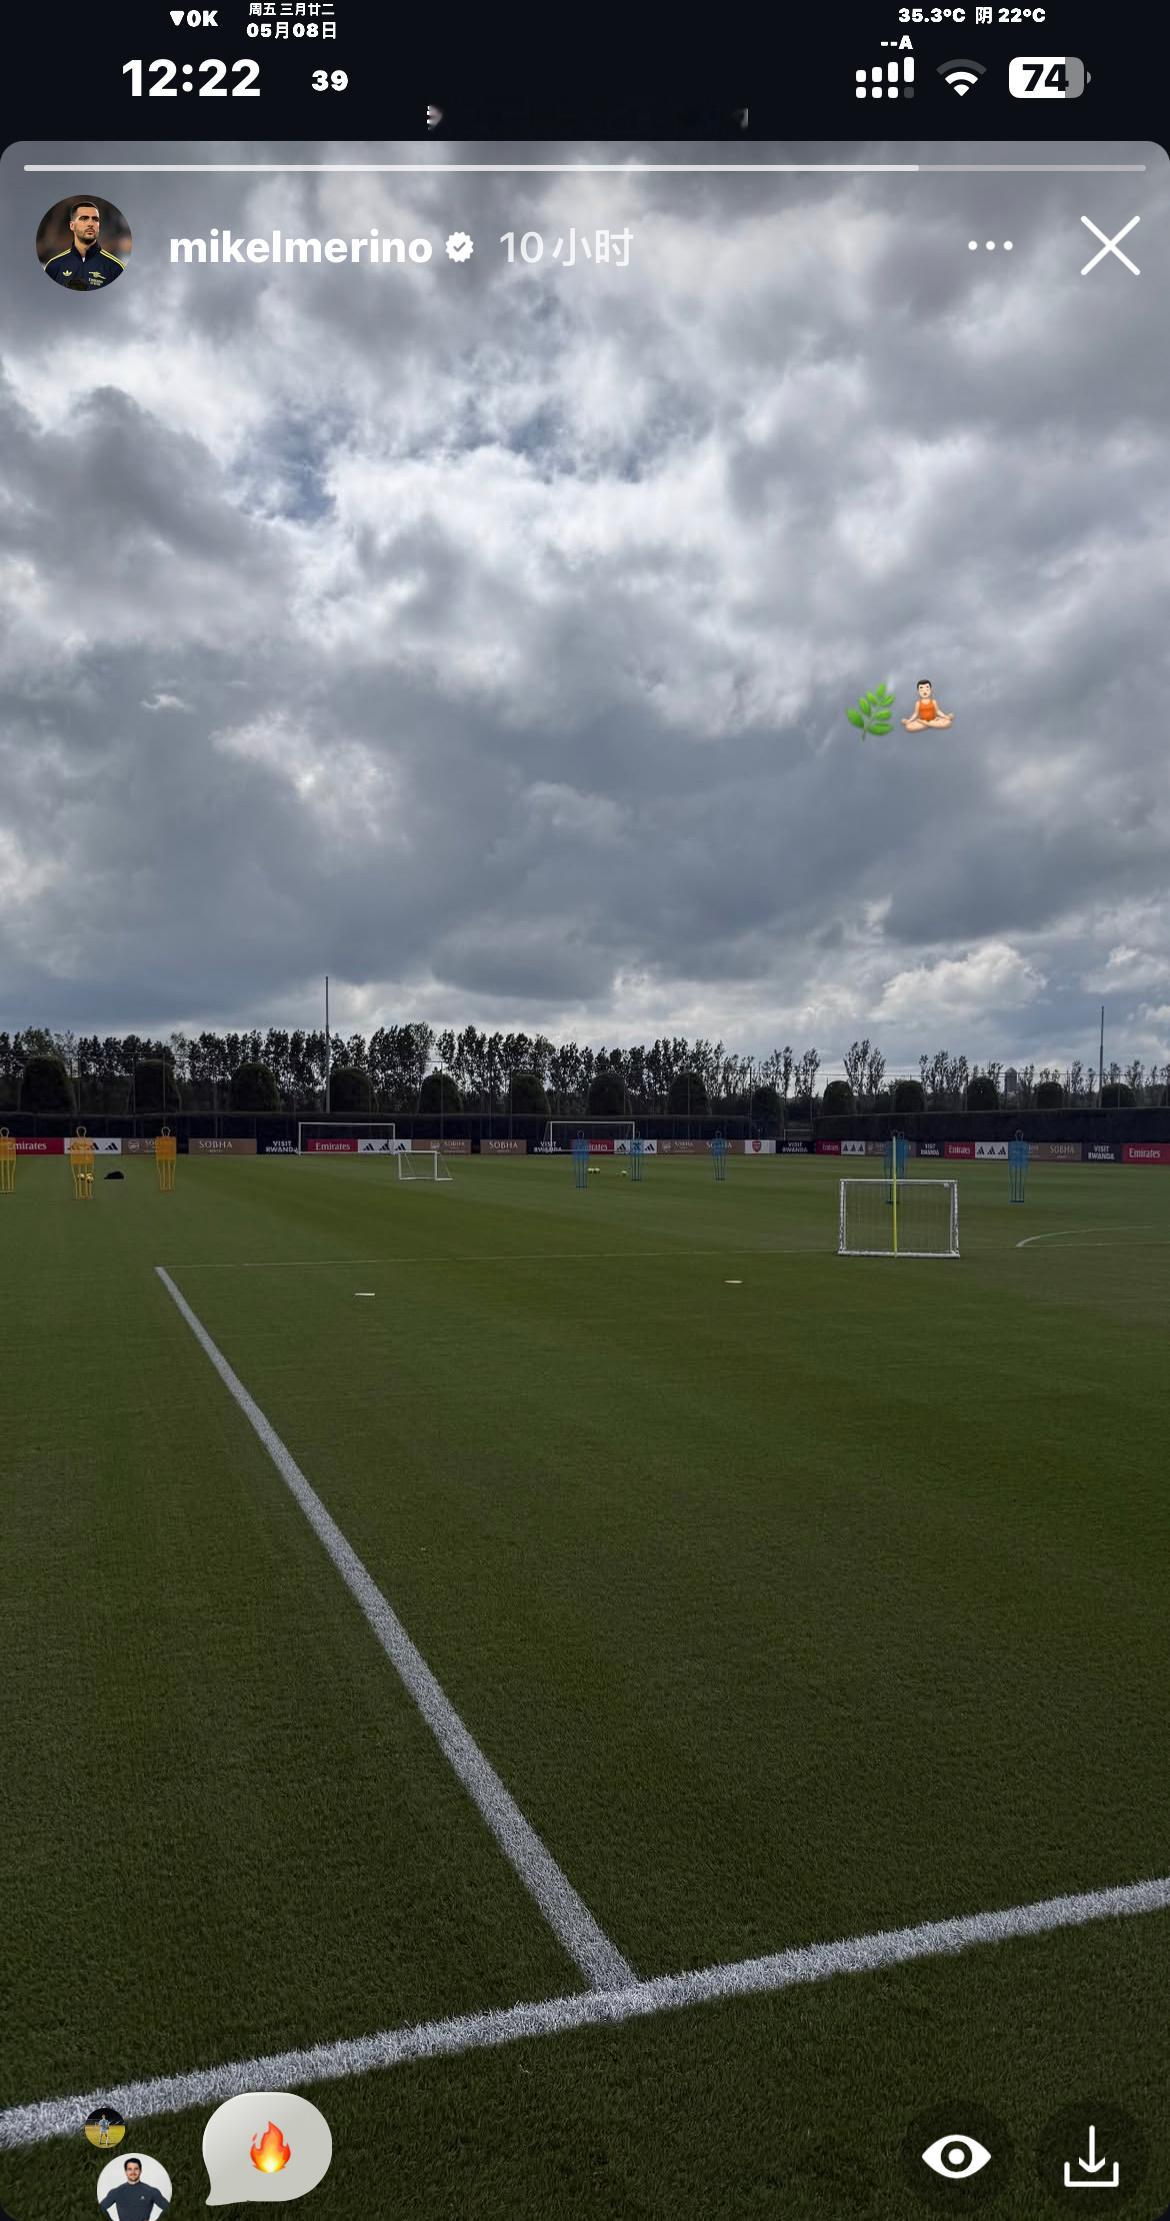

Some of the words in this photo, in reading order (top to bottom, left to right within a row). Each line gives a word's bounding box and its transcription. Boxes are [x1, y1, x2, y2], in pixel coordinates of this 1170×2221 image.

[199, 1140, 233, 1149] SOBHA
[315, 1142, 351, 1150] Emirates
[489, 1141, 518, 1149] SOBHA
[1049, 1145, 1075, 1154] SOBHA
[1129, 1148, 1161, 1159] Emirates
